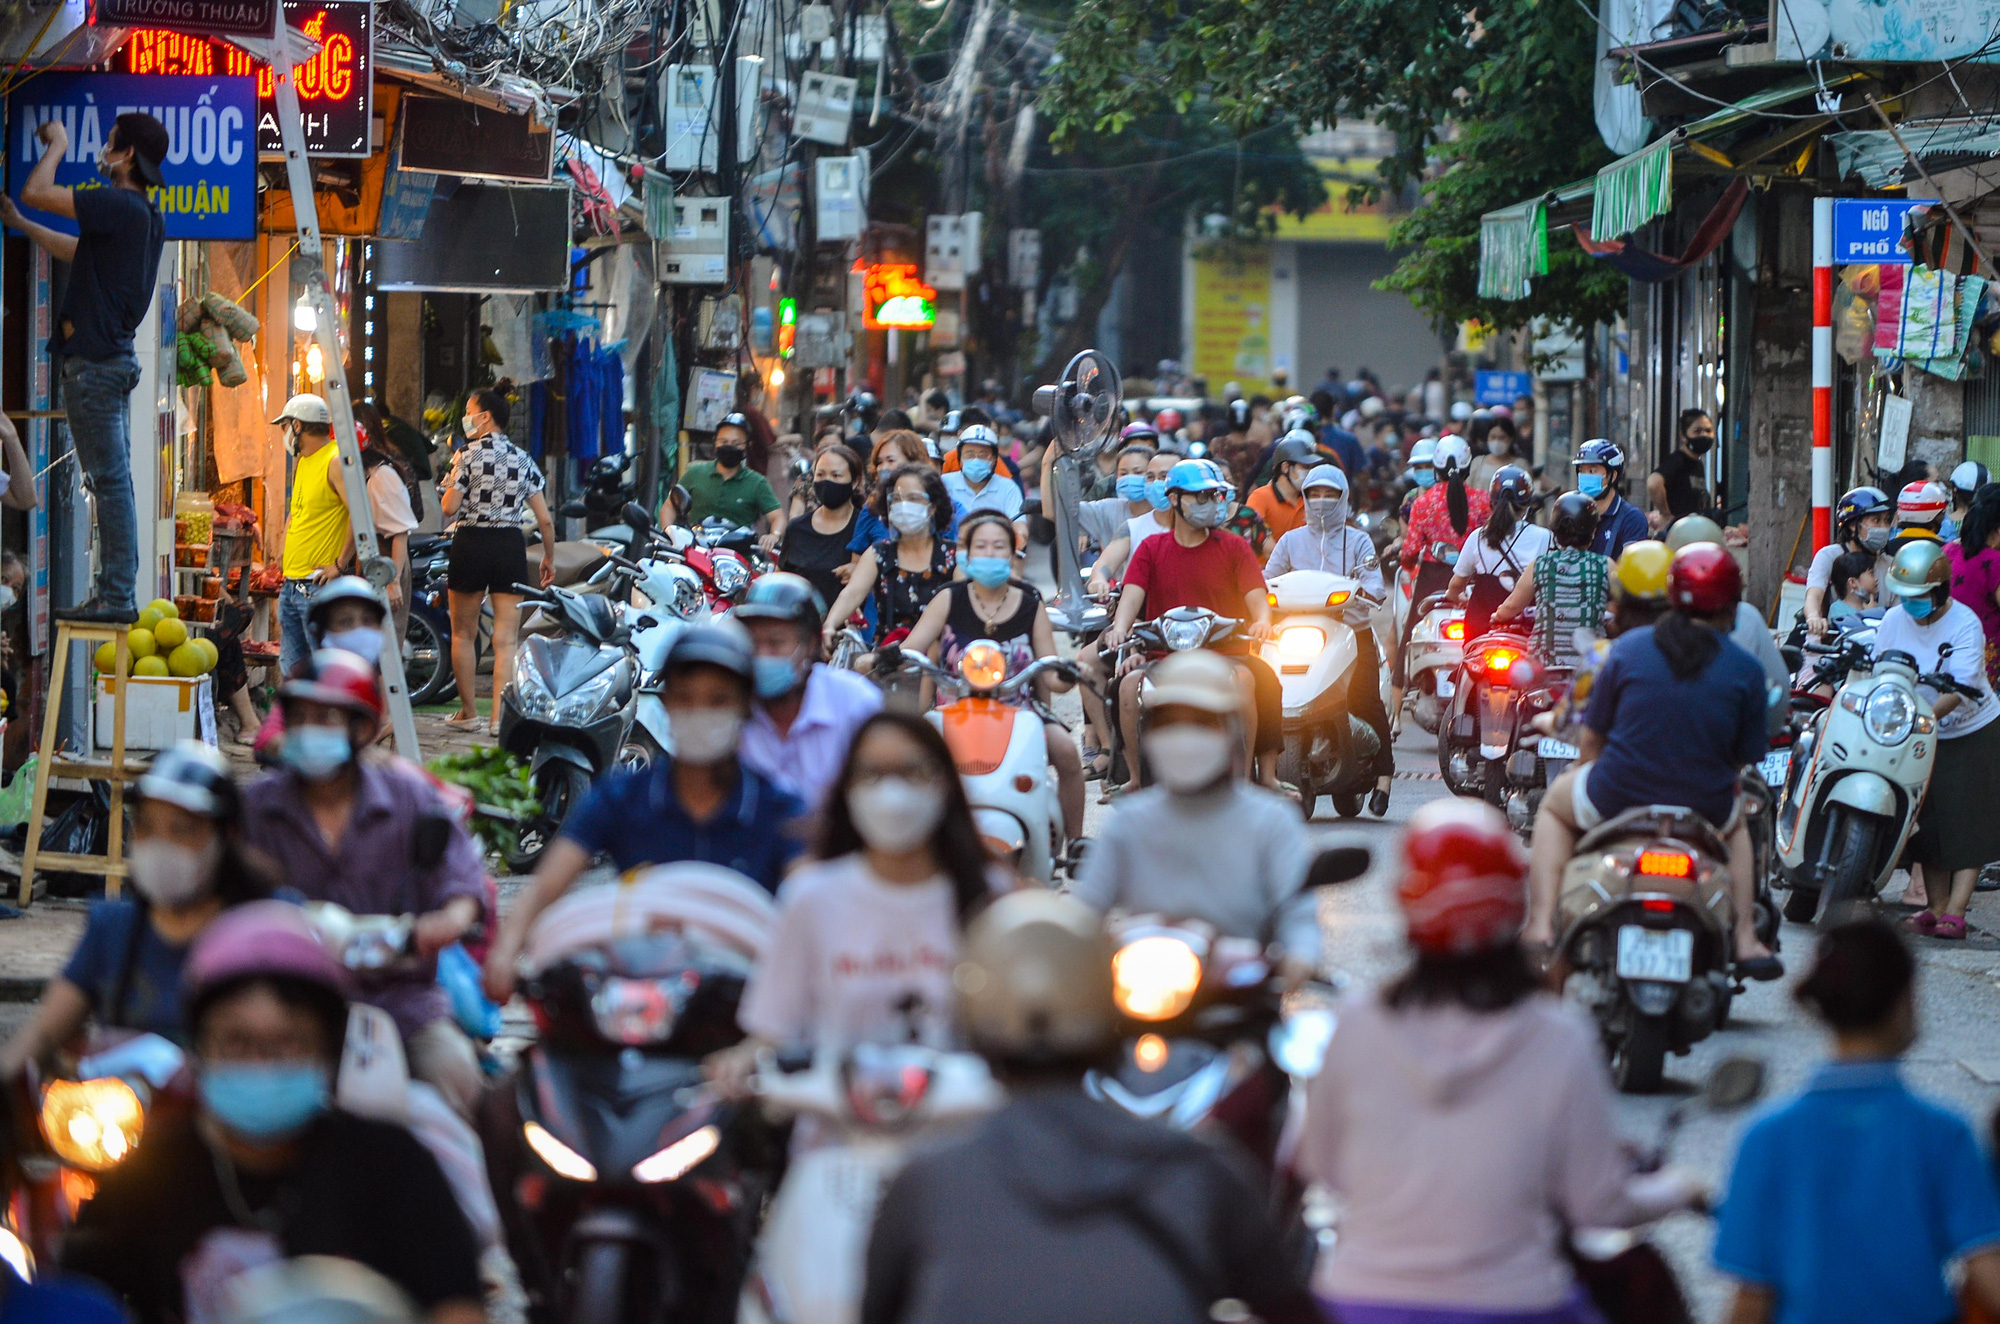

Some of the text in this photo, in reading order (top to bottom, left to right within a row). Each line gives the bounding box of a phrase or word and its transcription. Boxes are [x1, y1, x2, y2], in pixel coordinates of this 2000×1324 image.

[22, 85, 243, 166] NHÀ UỐC
[258, 112, 328, 137] AH
[146, 180, 229, 219] THUẬN
[1862, 205, 1889, 231] NGÕ
[1849, 237, 1890, 254] PHỐ
